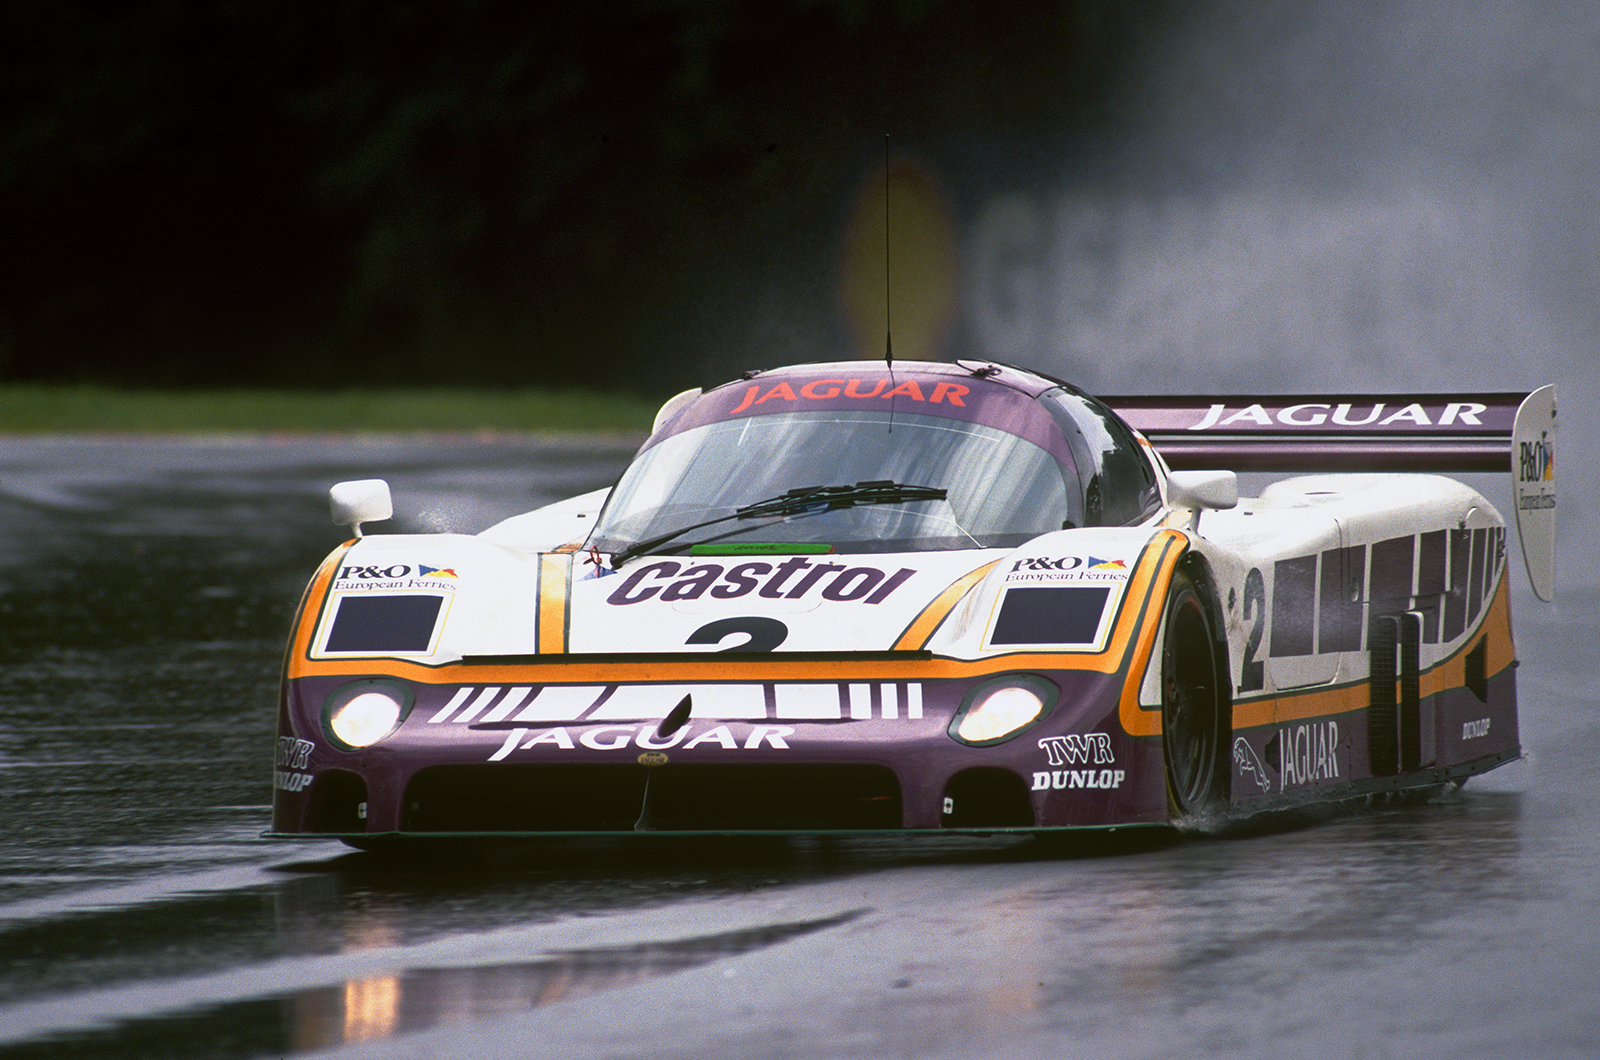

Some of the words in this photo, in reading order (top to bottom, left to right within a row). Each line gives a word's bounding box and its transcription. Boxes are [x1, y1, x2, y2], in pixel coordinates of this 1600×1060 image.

[730, 379, 970, 414] JAGUAR
[1187, 403, 1487, 430] JAGUAR
[1520, 441, 1542, 482] P&O
[337, 564, 411, 579] P&O
[606, 557, 918, 606] Castrol
[1005, 572, 1073, 582] European
[1079, 571, 1128, 580] Ferries
[1008, 556, 1083, 573] P&O
[334, 580, 403, 590] European
[408, 579, 456, 590] Ferries
[1240, 567, 1266, 692] 2
[487, 726, 796, 761] JAGUAR
[1038, 732, 1115, 766] TWR
[1279, 721, 1339, 794] JAGUAR
[1031, 769, 1125, 791] DUNLOP
